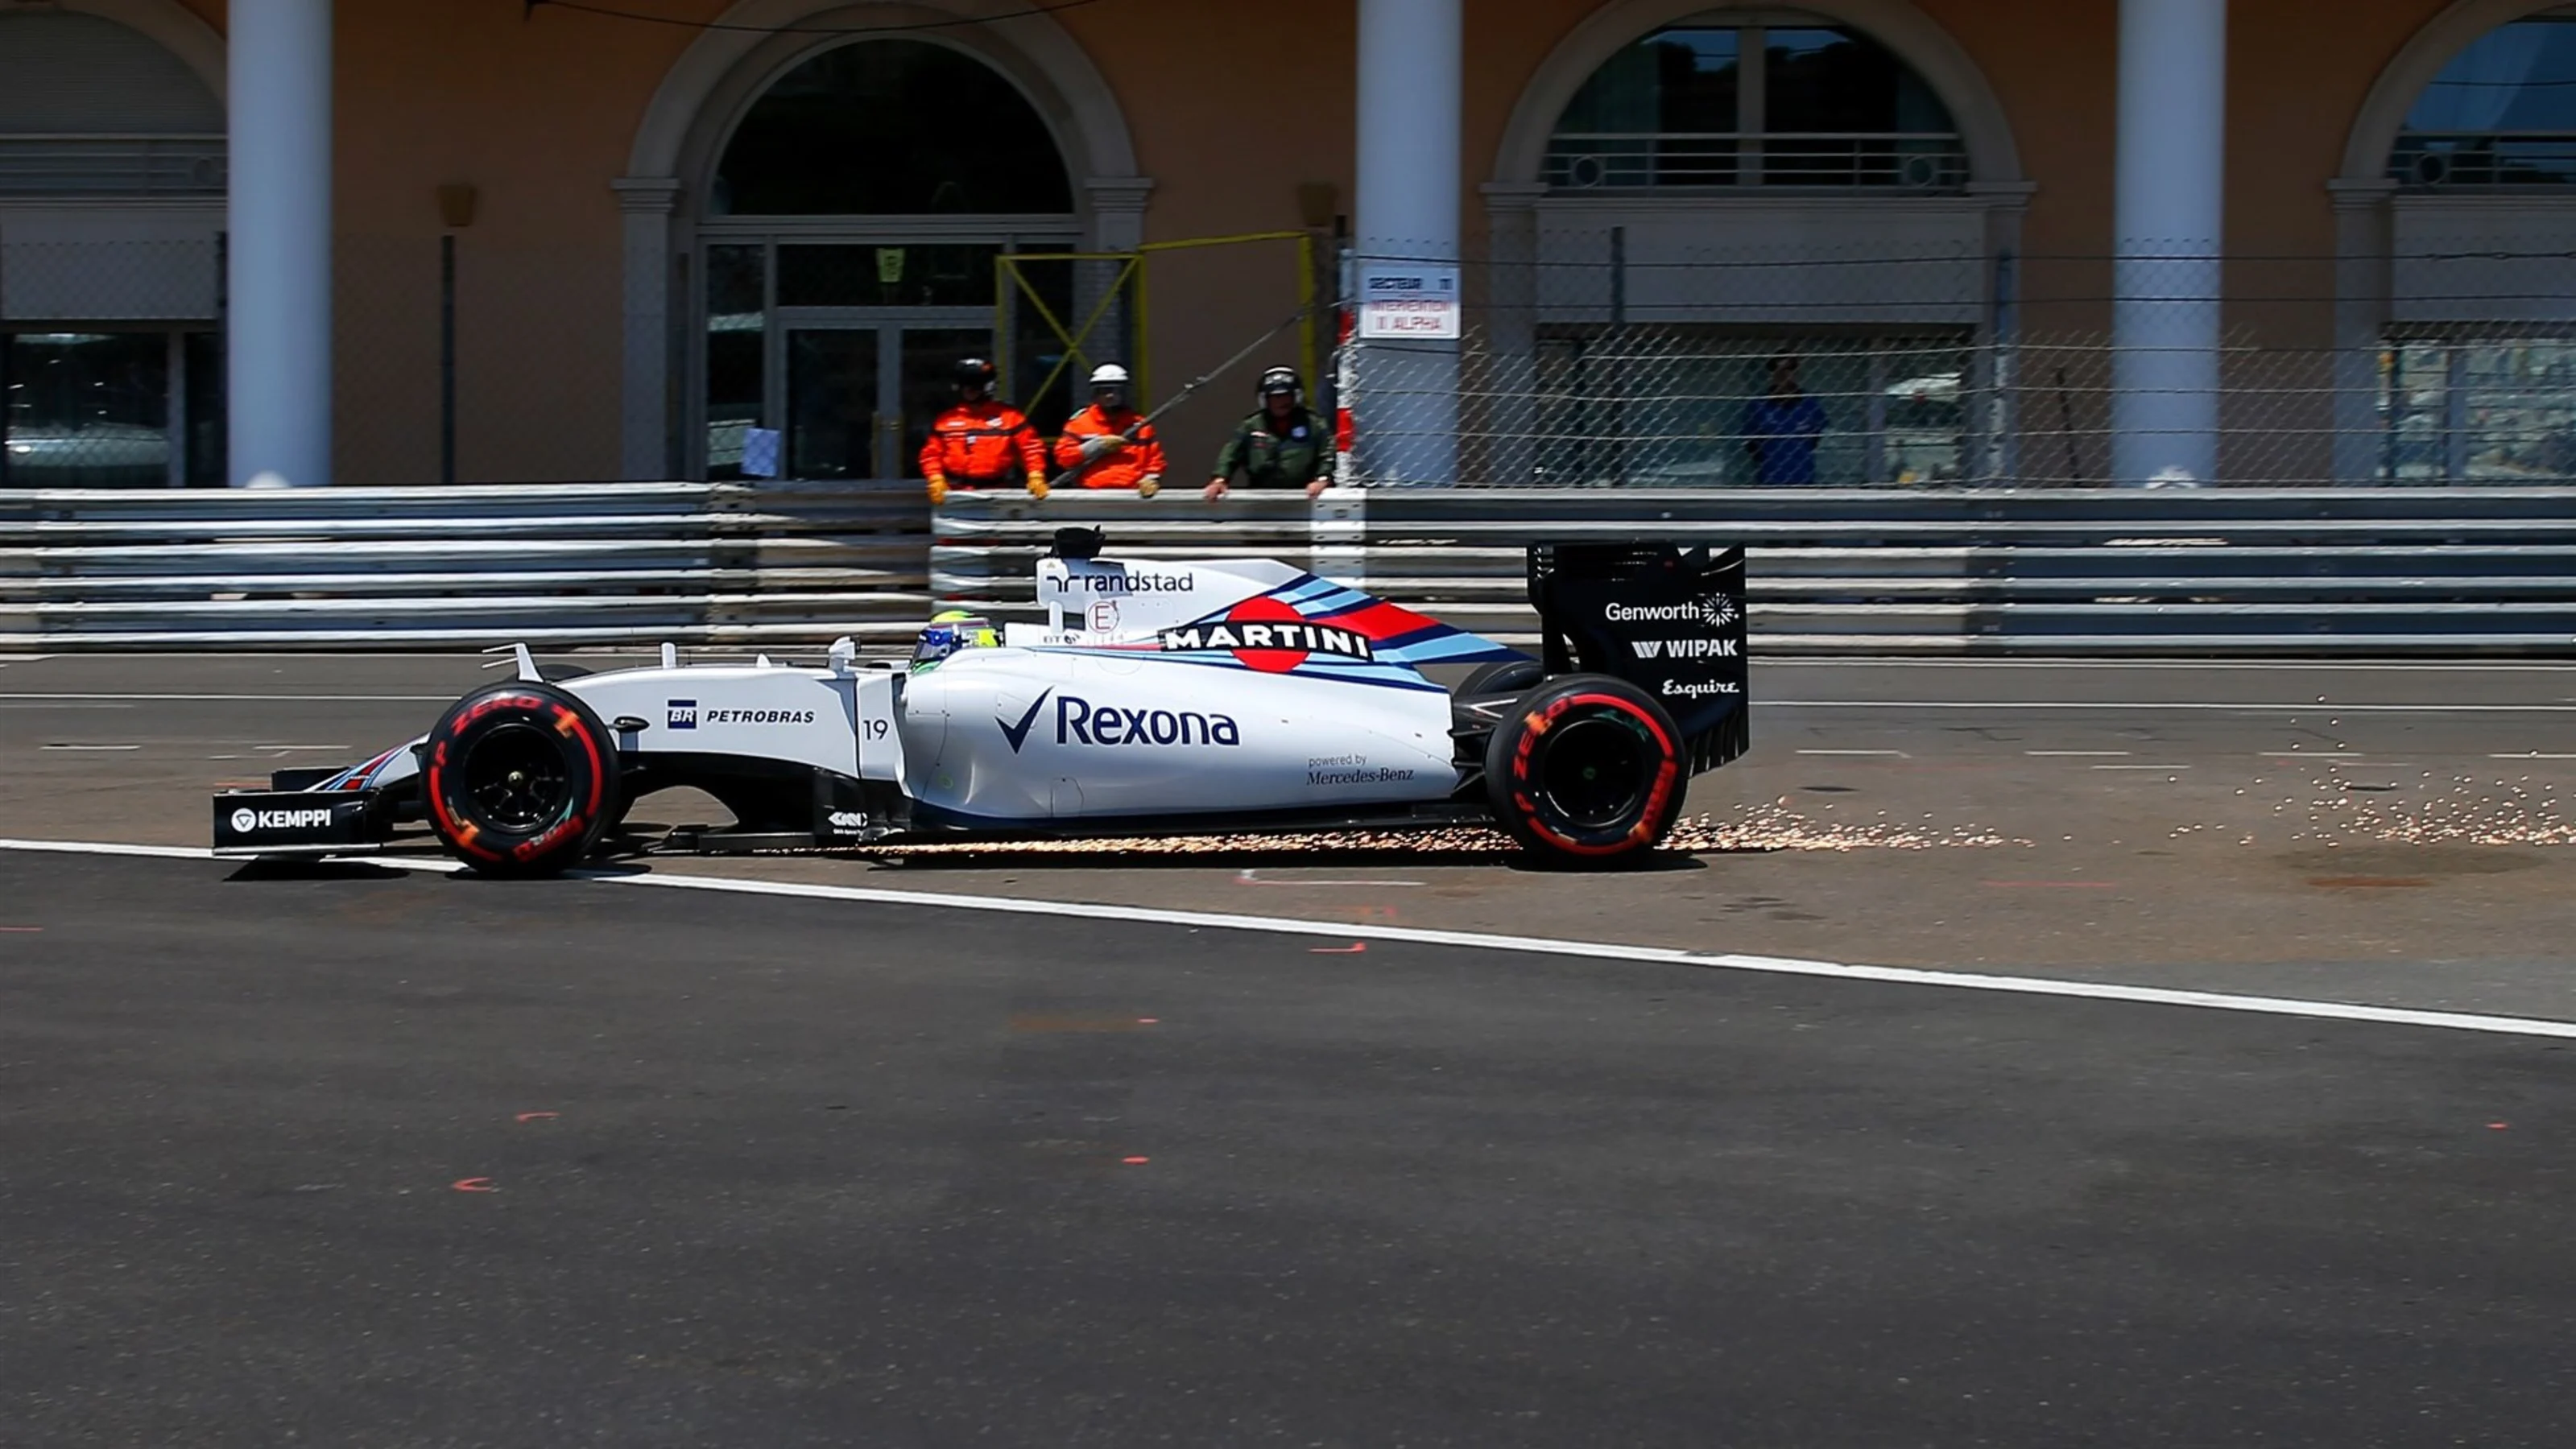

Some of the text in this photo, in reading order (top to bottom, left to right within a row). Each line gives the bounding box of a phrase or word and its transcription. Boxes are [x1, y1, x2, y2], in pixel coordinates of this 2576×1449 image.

[1085, 571, 1193, 592] randstad
[1094, 605, 1110, 630] E
[1606, 601, 1699, 621] Genworth
[1166, 624, 1369, 658] MARTINI
[1666, 639, 1738, 658] WIPAK
[1662, 679, 1739, 699] Esquire
[670, 710, 814, 723] BR PETROBRAS
[1056, 696, 1240, 745] Rexona
[862, 719, 889, 741] 19
[1309, 754, 1367, 767] powered by
[1307, 767, 1415, 785] Mercedes-Benz
[258, 809, 331, 828] KEMPPI
